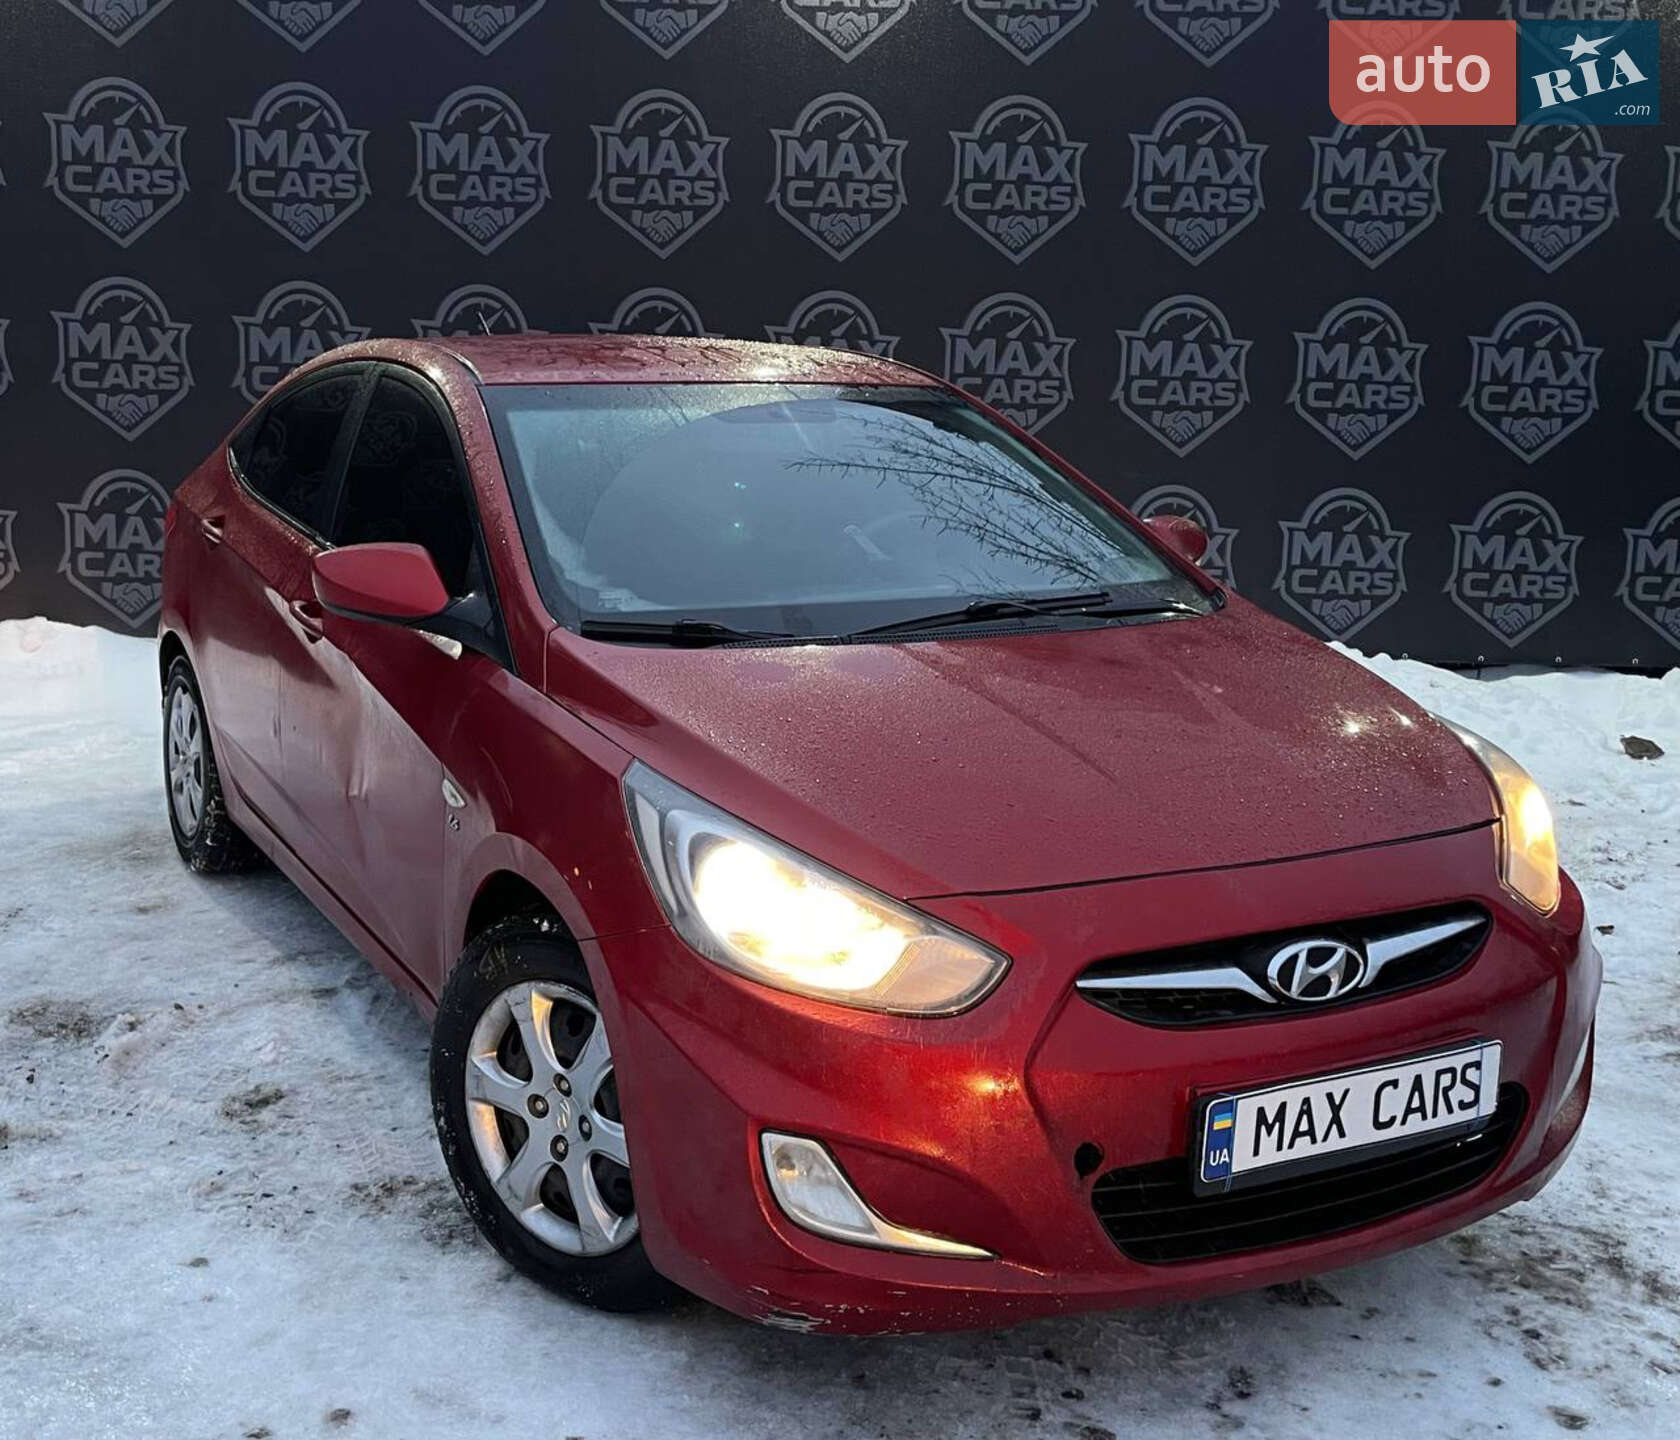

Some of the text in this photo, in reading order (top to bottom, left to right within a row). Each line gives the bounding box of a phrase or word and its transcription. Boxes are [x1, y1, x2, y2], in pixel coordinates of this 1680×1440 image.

[62, 124, 175, 168] MAX
[246, 130, 358, 171] MAX
[426, 133, 537, 174] MAX
[607, 135, 717, 178] MAX
[785, 138, 895, 180] MAX
[963, 141, 1075, 183] MAX
[64, 165, 174, 195] CARS
[248, 170, 357, 199] CARS
[1141, 147, 1254, 187] MAX
[1322, 149, 1432, 189] MAX
[1501, 152, 1611, 193] MAX
[429, 173, 536, 201] CARS
[609, 177, 715, 204] CARS
[787, 180, 893, 208] CARS
[964, 183, 1071, 211] CARS
[1143, 185, 1251, 214] CARS
[1323, 187, 1430, 217] CARS
[1501, 191, 1606, 221] CARS
[70, 322, 181, 362] MAX
[250, 325, 356, 362] MA
[954, 336, 1063, 377] MAX
[72, 361, 179, 390] CARS
[1129, 343, 1242, 380] MAX
[1305, 344, 1416, 383] MAX
[1480, 347, 1592, 386] MAX
[1131, 379, 1236, 406] CARS
[1306, 381, 1412, 409] CARS
[1481, 385, 1586, 413] CARS
[77, 551, 162, 578] CAR
[1291, 531, 1399, 569] MAX
[1464, 536, 1571, 572] MAX
[1291, 569, 1395, 596] CARS
[1464, 572, 1567, 599] CARS
[1253, 1060, 1481, 1157] MAX CARS
[1209, 1148, 1230, 1166] UA
